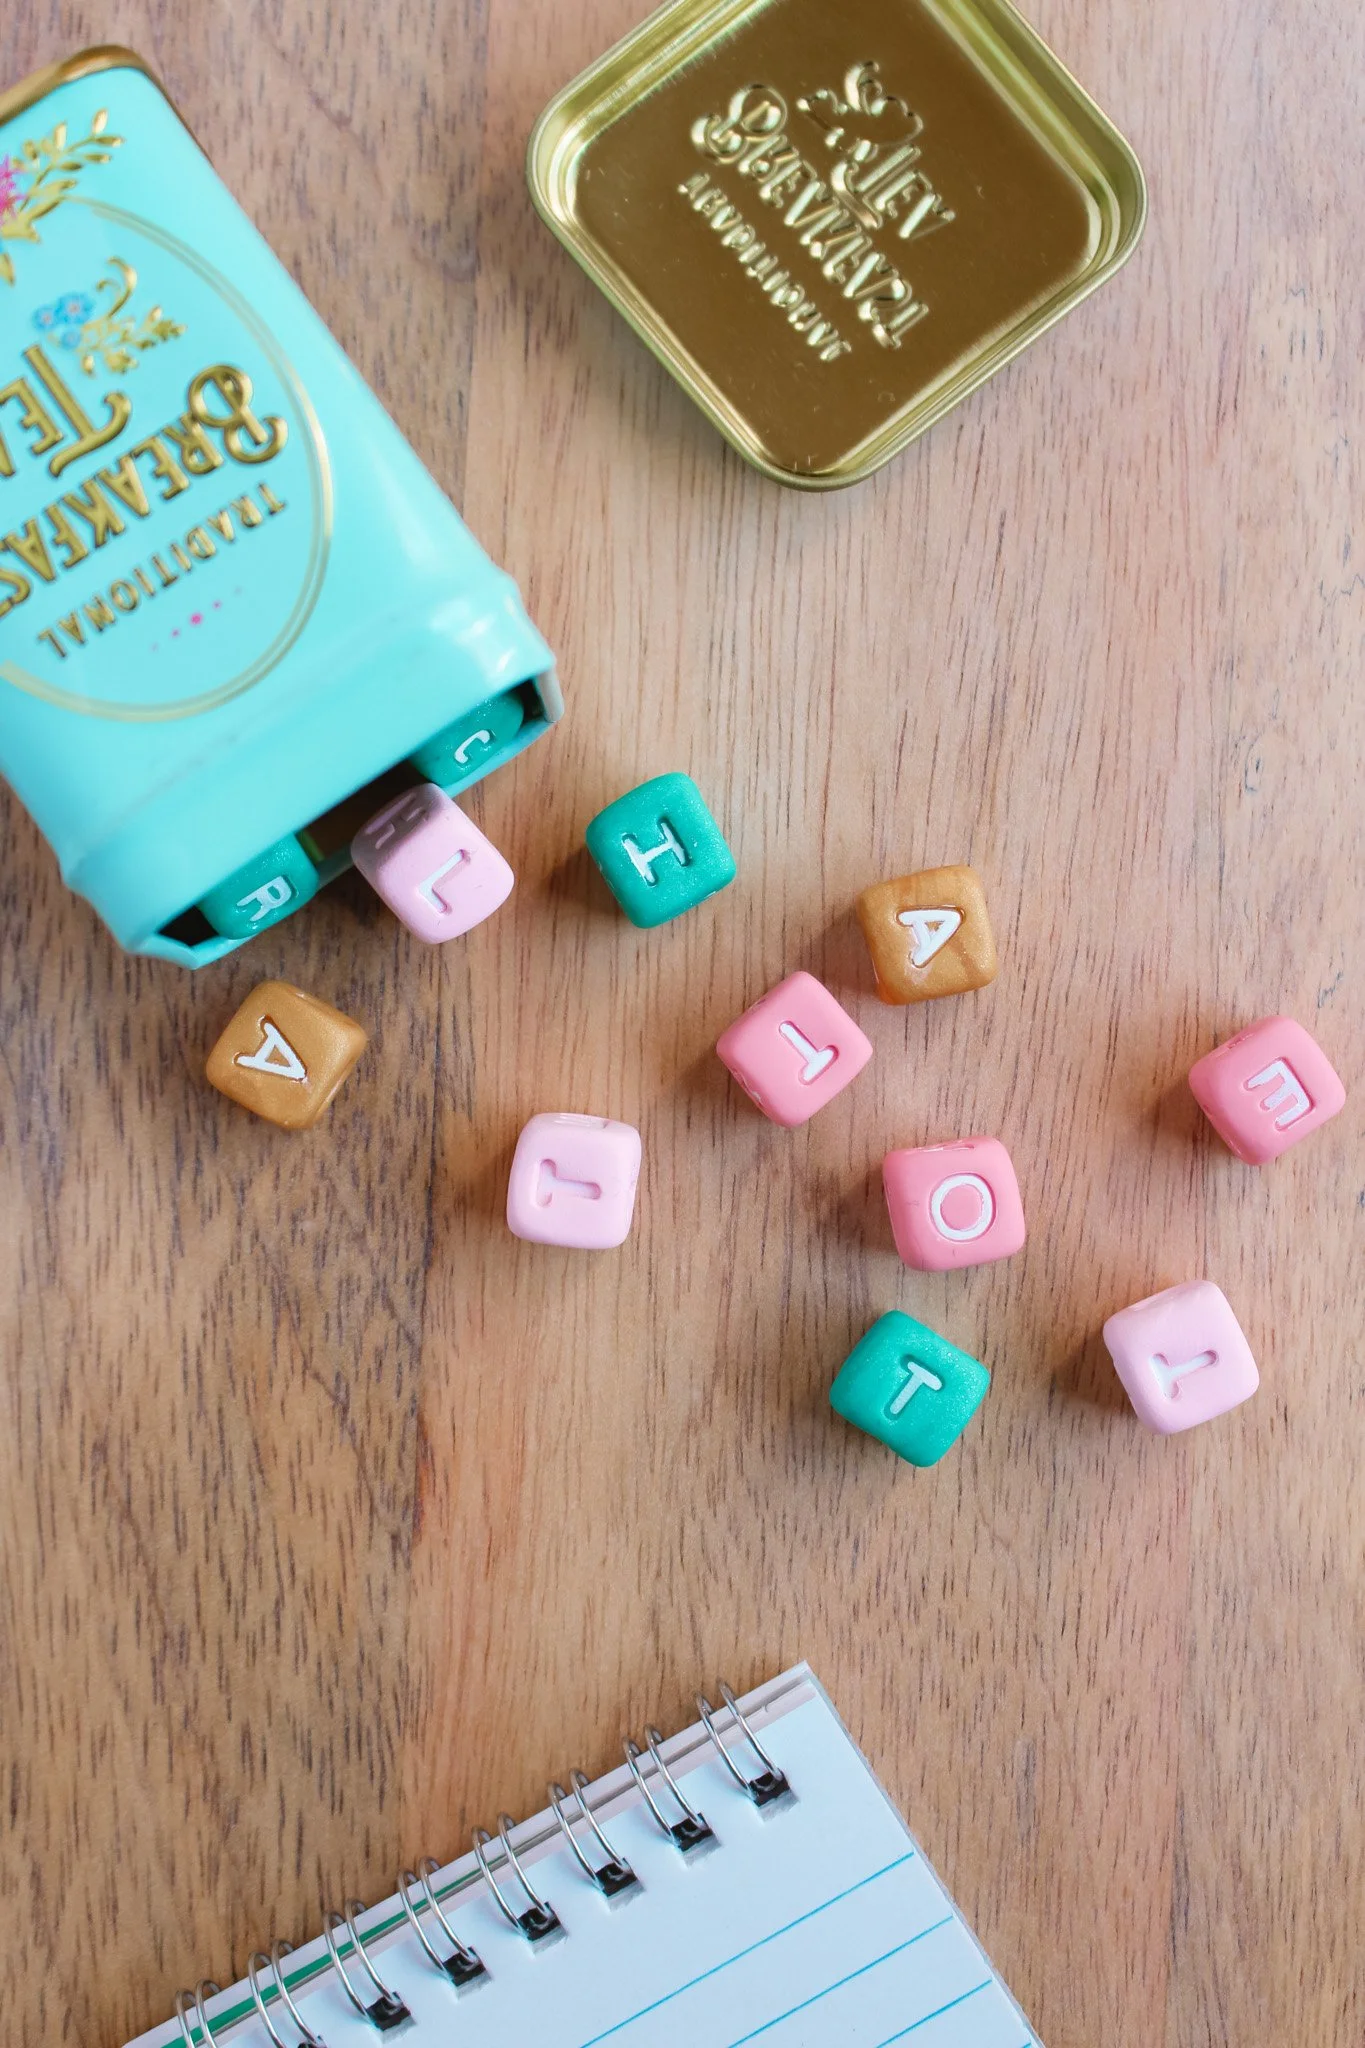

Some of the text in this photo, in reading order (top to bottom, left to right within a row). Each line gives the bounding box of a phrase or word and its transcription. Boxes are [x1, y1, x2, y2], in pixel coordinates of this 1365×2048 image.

[0, 363, 289, 620] BREAKFAS
[37, 482, 288, 660] TRADITIONAL
[454, 729, 496, 765] C
[418, 848, 472, 916] L
[621, 815, 693, 886] H
[236, 875, 299, 922] R
[898, 905, 964, 967] A
[233, 1015, 309, 1083] A
[1243, 1056, 1315, 1130] E
[930, 1172, 996, 1242] O
[884, 1357, 944, 1418] T
[1149, 1350, 1218, 1400] T
